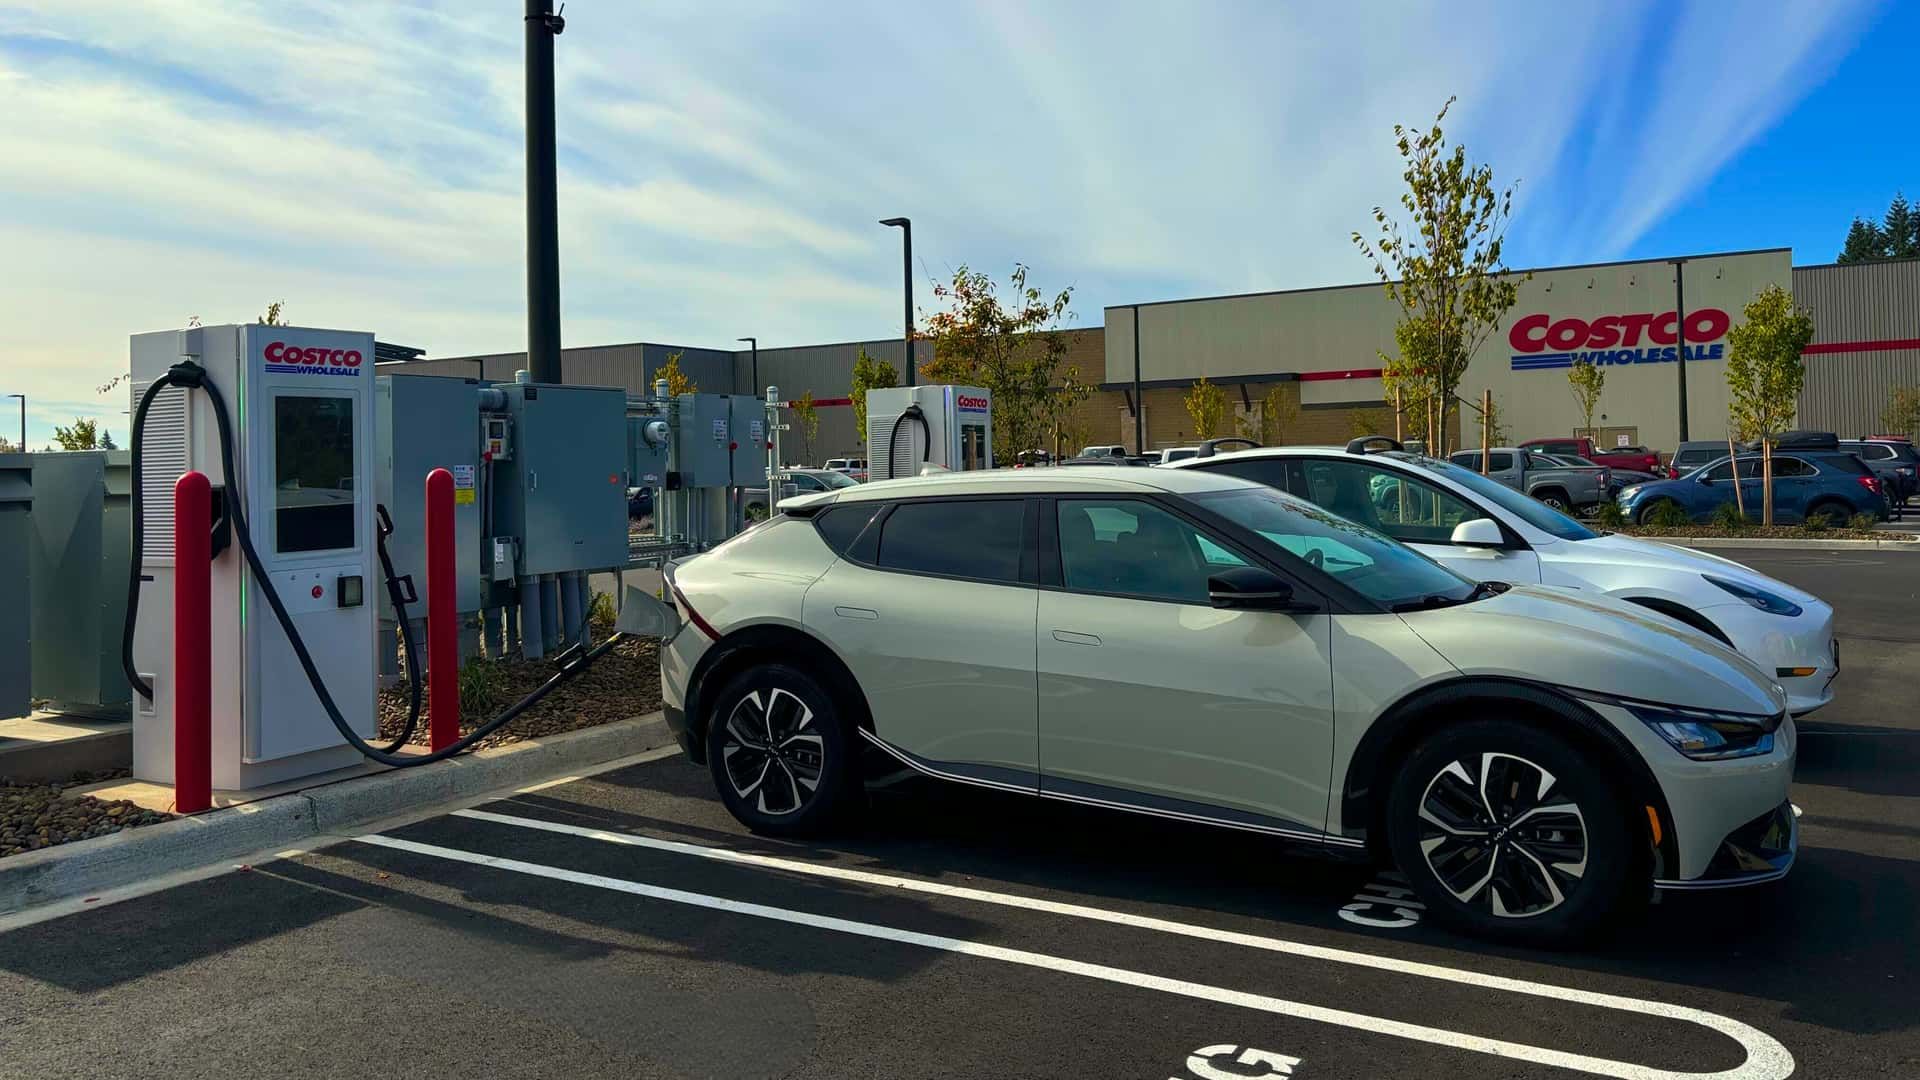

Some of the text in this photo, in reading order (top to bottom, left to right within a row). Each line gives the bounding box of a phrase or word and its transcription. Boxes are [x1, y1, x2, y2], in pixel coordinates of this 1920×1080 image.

[1509, 308, 1730, 352] COSTCO
[264, 341, 362, 367] COSTCO
[1570, 343, 1724, 367] WHOLESALE
[296, 365, 360, 376] WHOLESALE
[958, 395, 987, 408] COSTCO
[1337, 872, 1427, 928] CH
